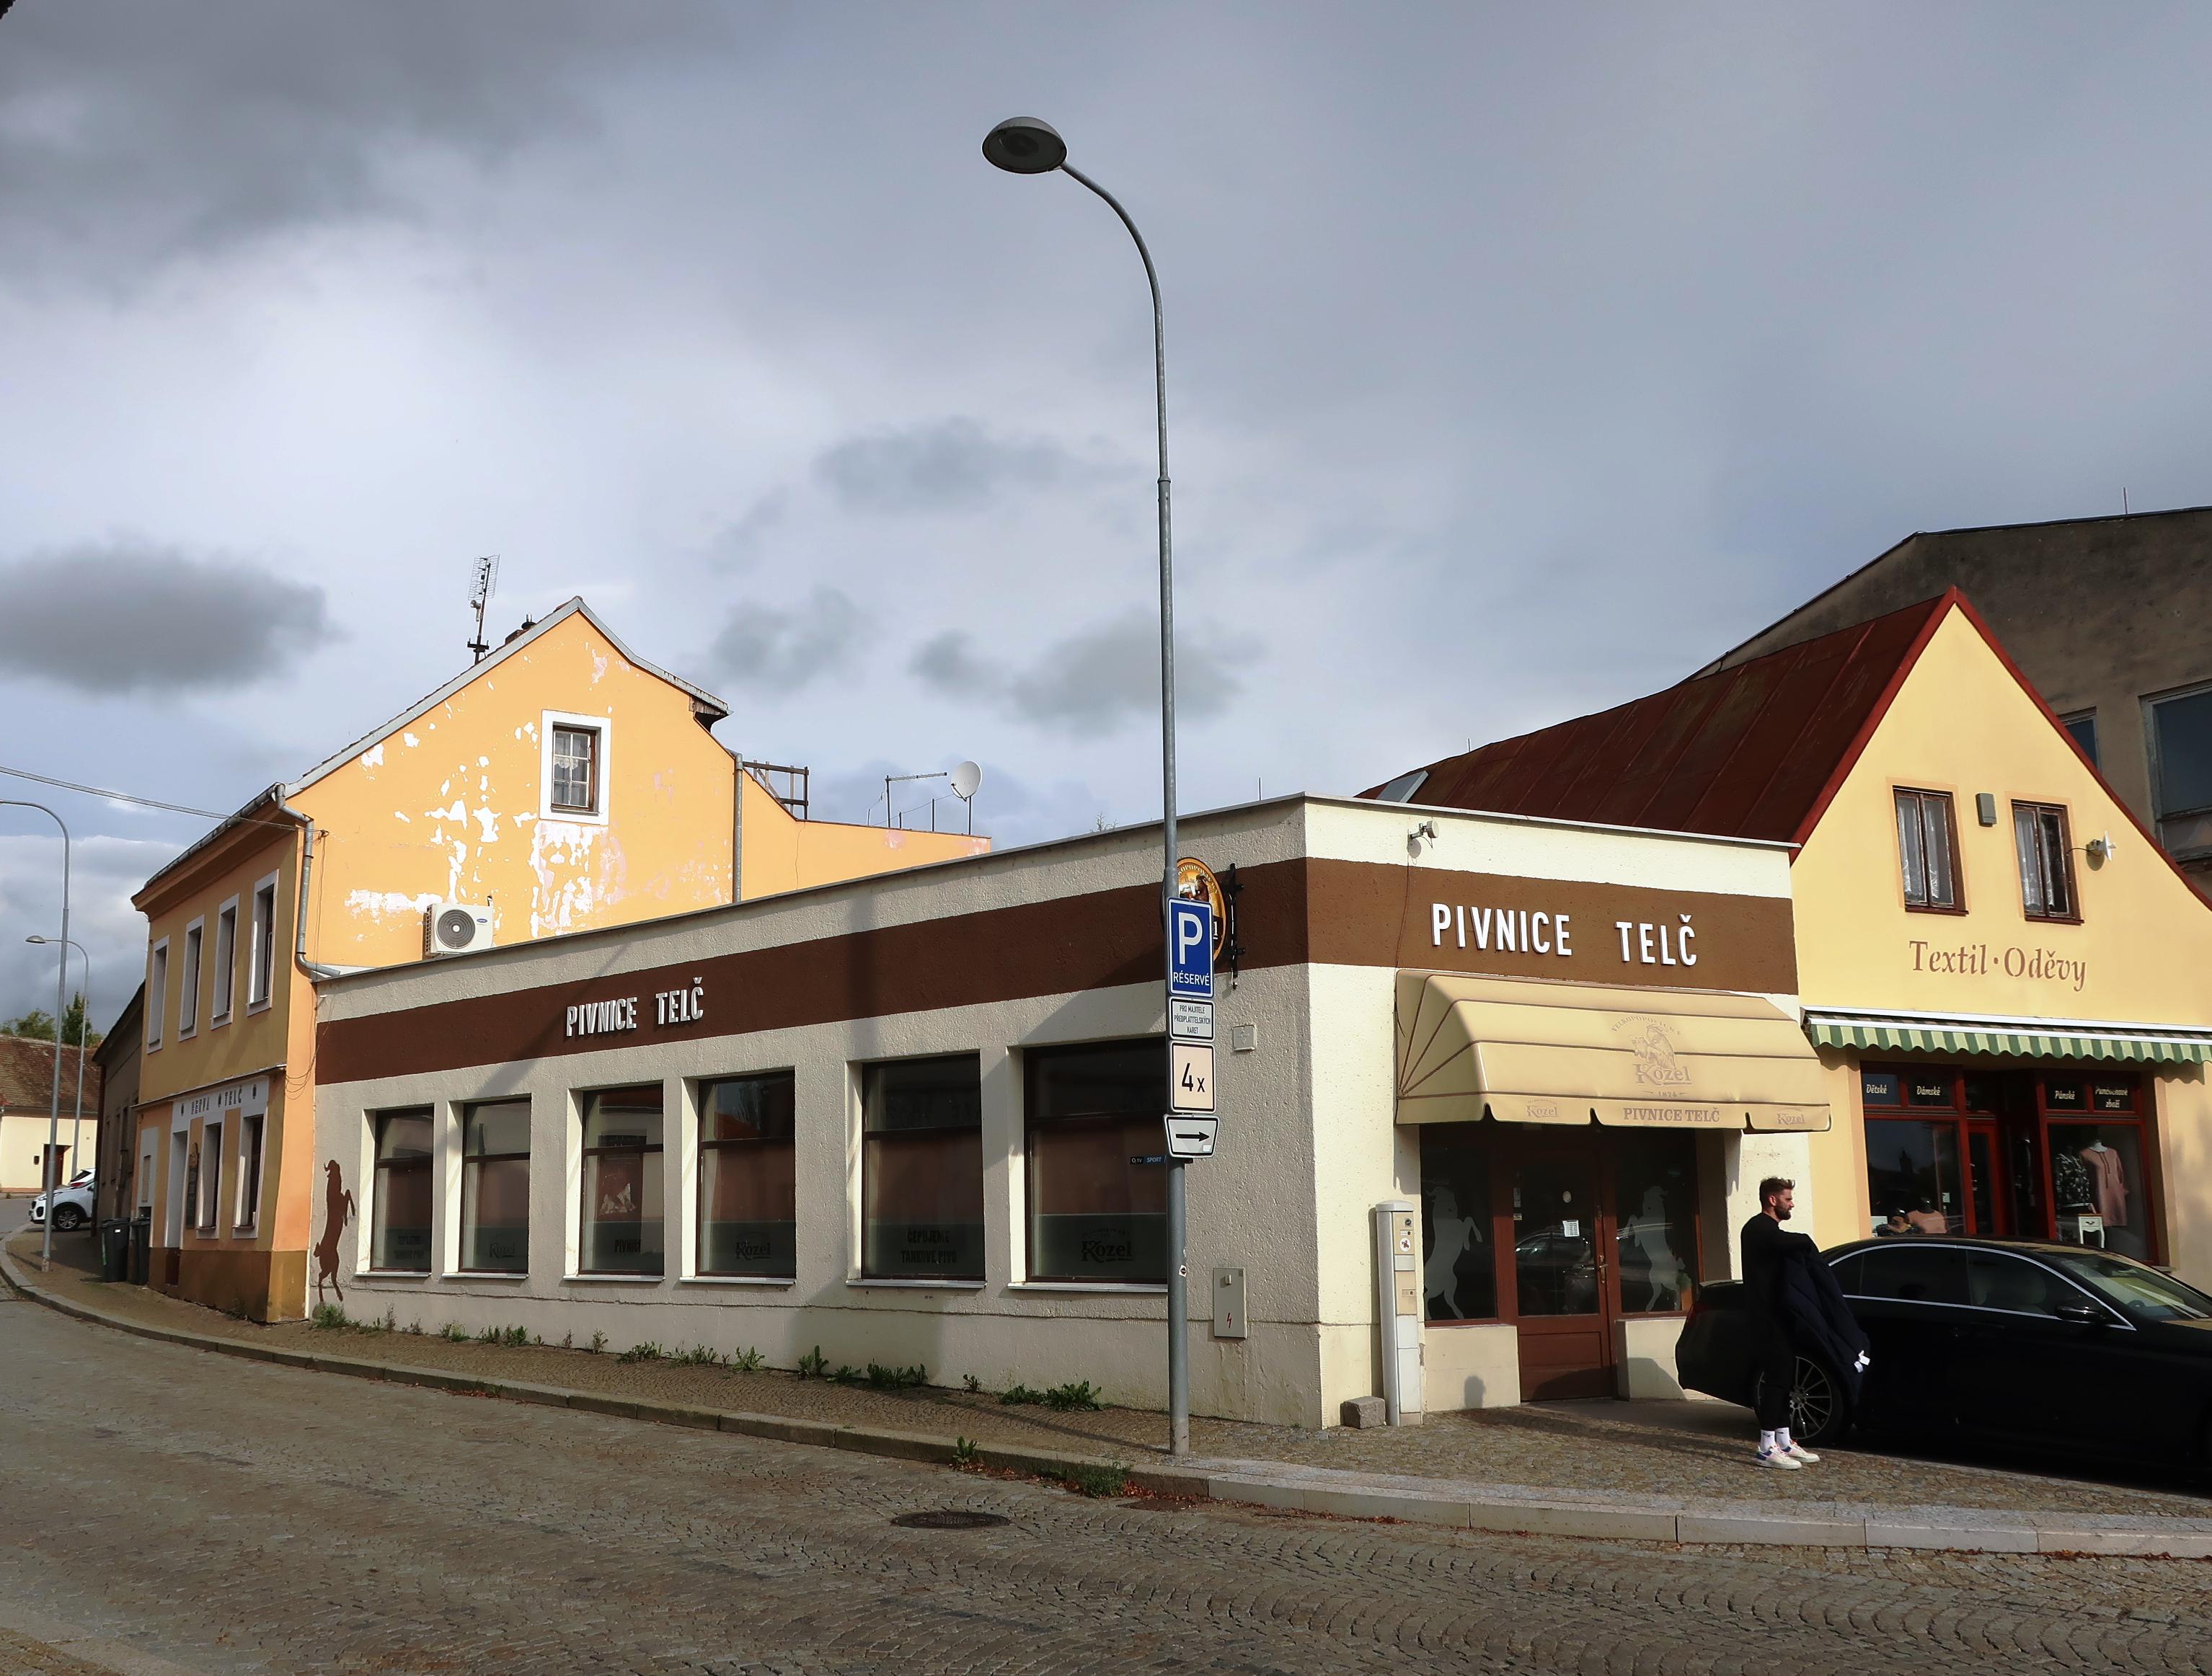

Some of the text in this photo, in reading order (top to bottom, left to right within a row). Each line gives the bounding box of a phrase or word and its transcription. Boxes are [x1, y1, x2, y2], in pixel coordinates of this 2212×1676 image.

[1178, 912, 1203, 965] P
[1431, 903, 1697, 966] PIVNICE TELČ
[1909, 940, 2086, 992] Textil Oděvy
[1173, 970, 1210, 986] RÉSERVÉ
[566, 977, 704, 1037] PIVNICE TELČ
[1187, 1026, 1199, 1034] KARET
[1632, 1063, 1691, 1086] Kozel
[1866, 1084, 1887, 1094] Dětské
[1916, 1086, 1941, 1096] Dámské
[1526, 1104, 1559, 1118] Kozel
[1623, 1107, 1720, 1122] PIVNICE TELČ
[1080, 1240, 1134, 1263] Kozel
